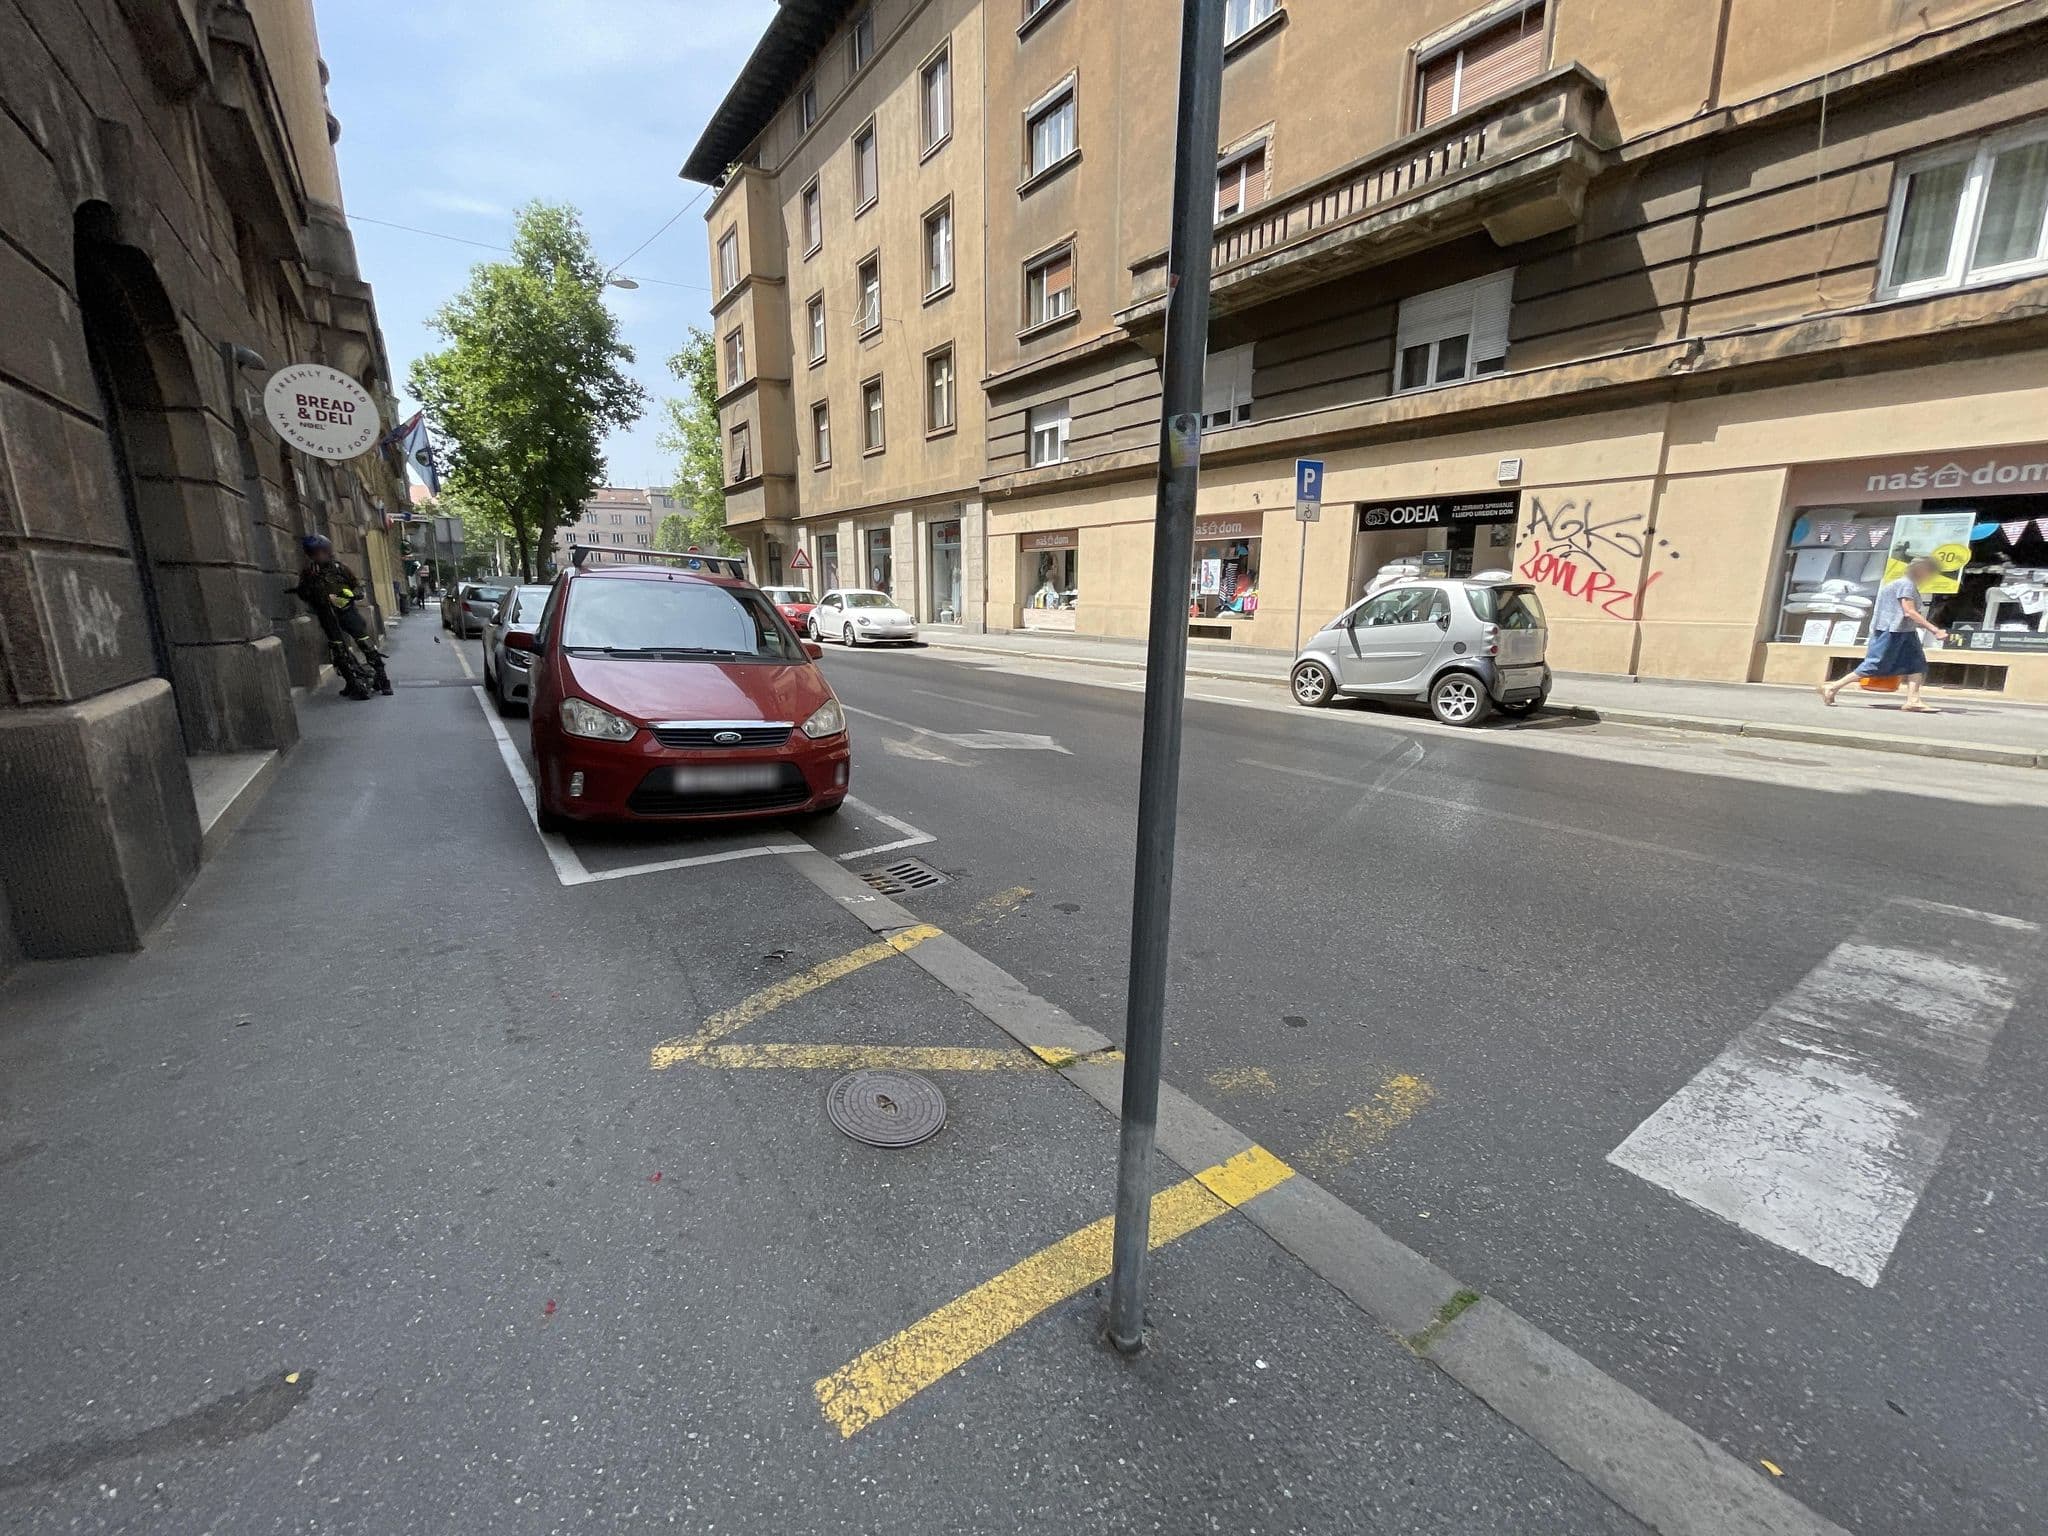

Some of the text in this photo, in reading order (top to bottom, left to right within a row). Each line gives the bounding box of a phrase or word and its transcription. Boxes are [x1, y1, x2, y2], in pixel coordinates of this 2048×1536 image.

[275, 370, 367, 403] FRESHLY BAKED
[296, 393, 355, 413] BREAD
[297, 407, 353, 426] & DELI
[278, 412, 371, 454] HANDMADE FOOD
[1303, 467, 1316, 493] P
[1866, 460, 2048, 491] naš dom
[1391, 504, 1439, 524] ODEJA
[1219, 520, 1242, 534] dom
